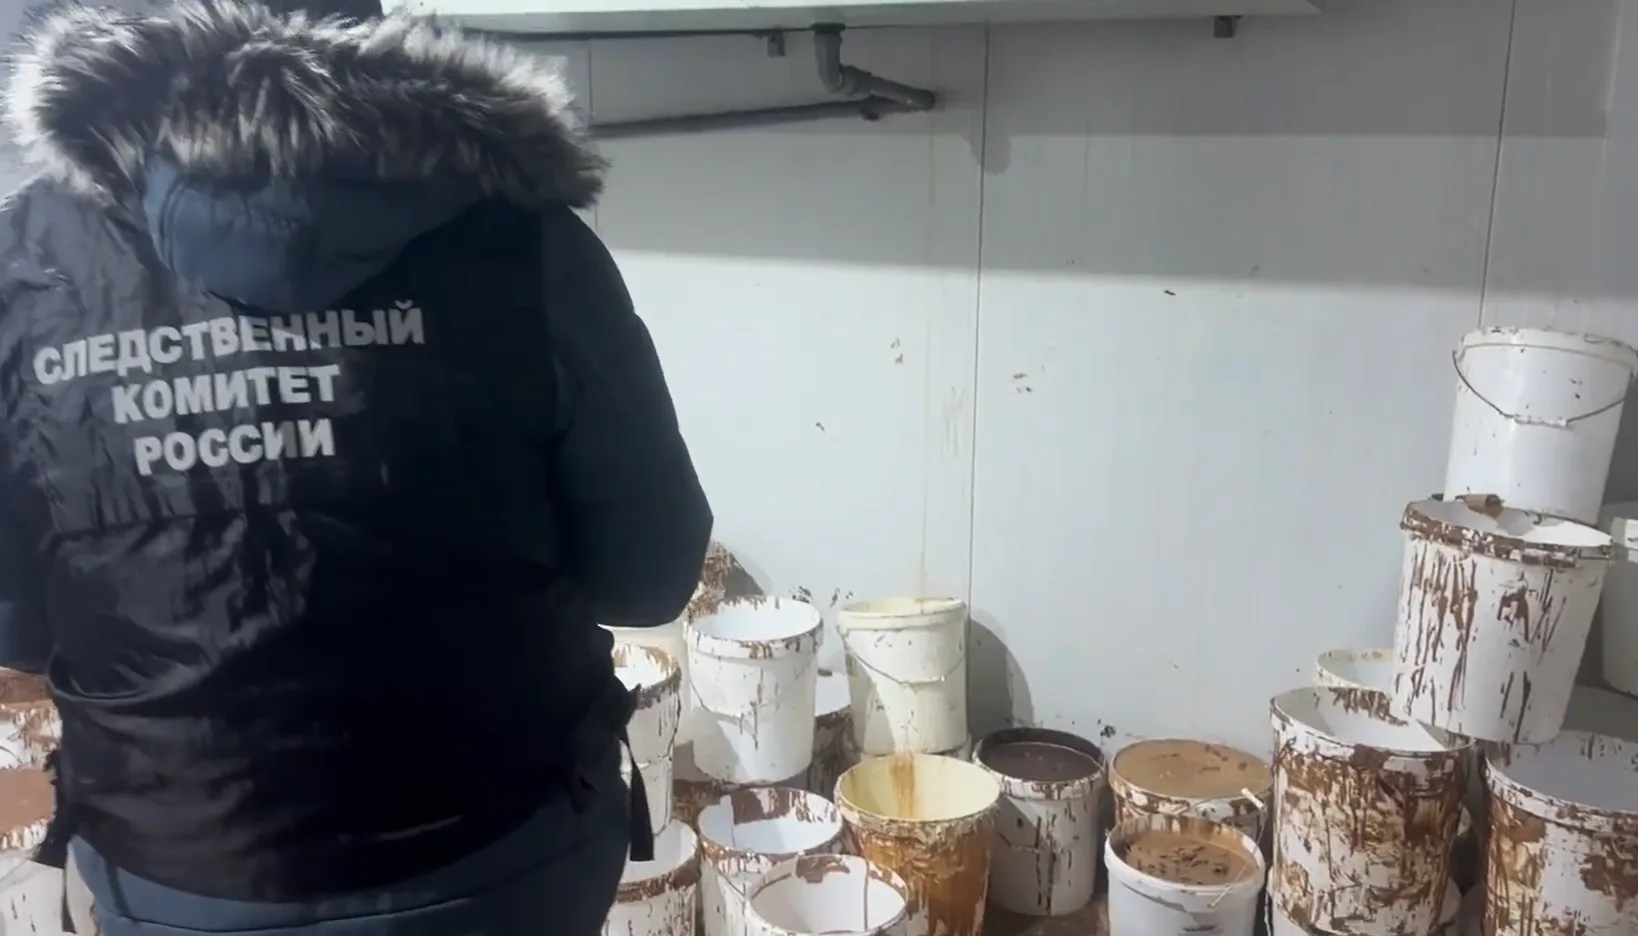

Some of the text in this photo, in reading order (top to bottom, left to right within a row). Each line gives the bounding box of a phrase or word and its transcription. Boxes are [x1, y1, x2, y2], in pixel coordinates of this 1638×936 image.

[33, 300, 425, 385] СЛЕДСТВЕННЫЙ
[112, 364, 340, 424] КОМИТЕТ
[134, 418, 336, 476] РОССИИ
